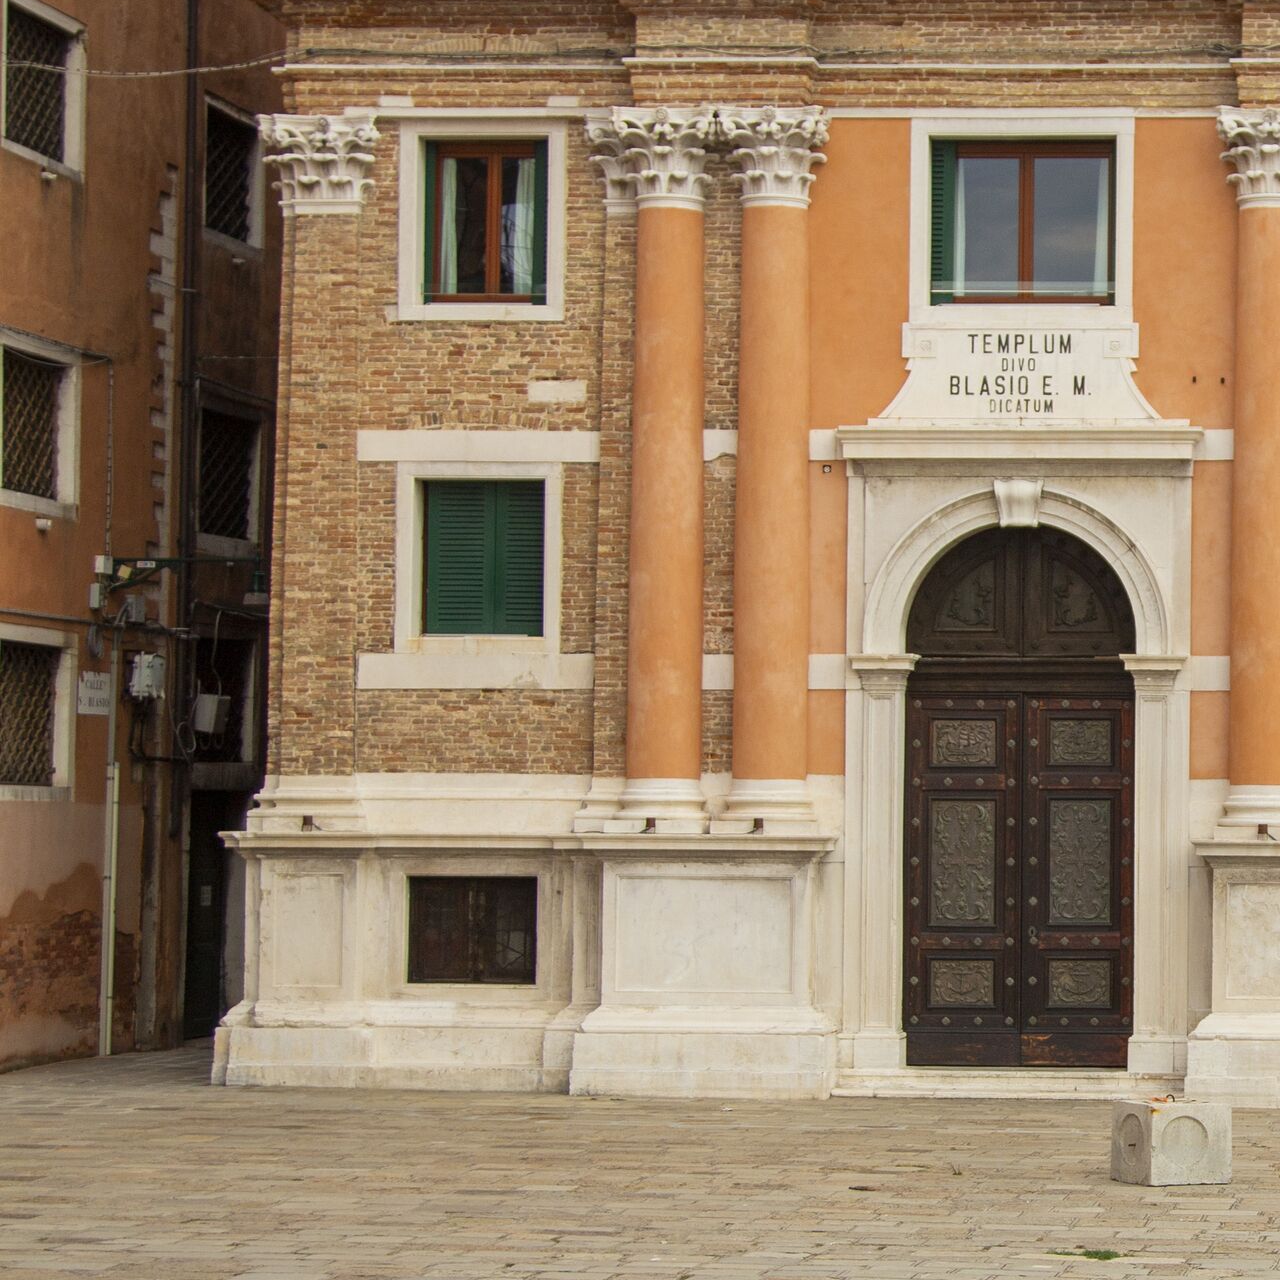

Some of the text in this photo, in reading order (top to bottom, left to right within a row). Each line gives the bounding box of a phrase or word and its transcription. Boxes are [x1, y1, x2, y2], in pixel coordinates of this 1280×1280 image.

[967, 334, 1072, 354] TEMPLUM
[1001, 358, 1036, 372] DIVO
[950, 375, 1092, 396] BLASIO E. M.
[989, 399, 1054, 413] DICATUM
